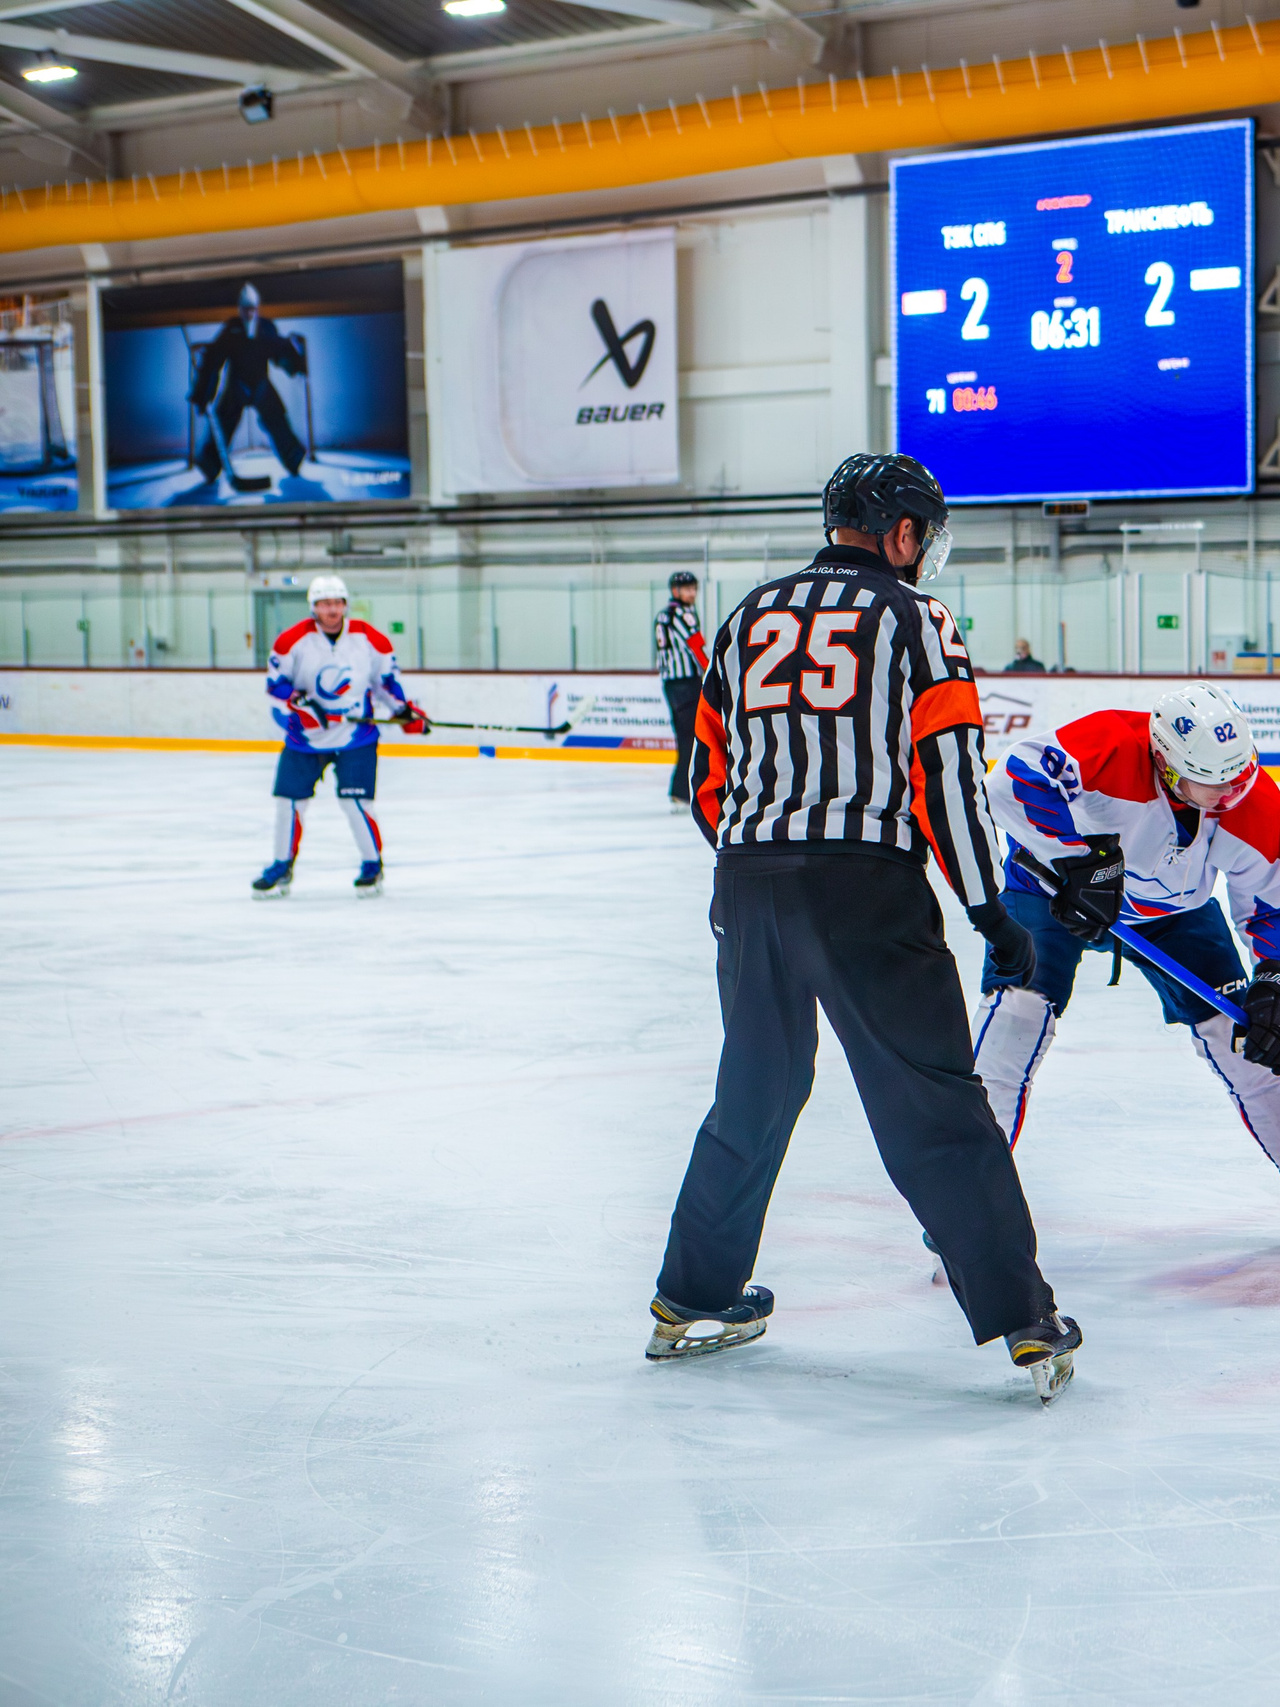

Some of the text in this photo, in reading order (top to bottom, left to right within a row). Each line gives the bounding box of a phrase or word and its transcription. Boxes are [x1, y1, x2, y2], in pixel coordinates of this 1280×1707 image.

[1055, 251, 1073, 283] 2
[960, 277, 990, 340] 2
[1145, 261, 1176, 327] 2
[1030, 307, 1100, 351] 06:31
[576, 403, 665, 424] BAUER
[744, 611, 861, 712] 25
[1214, 722, 1238, 743] 82
